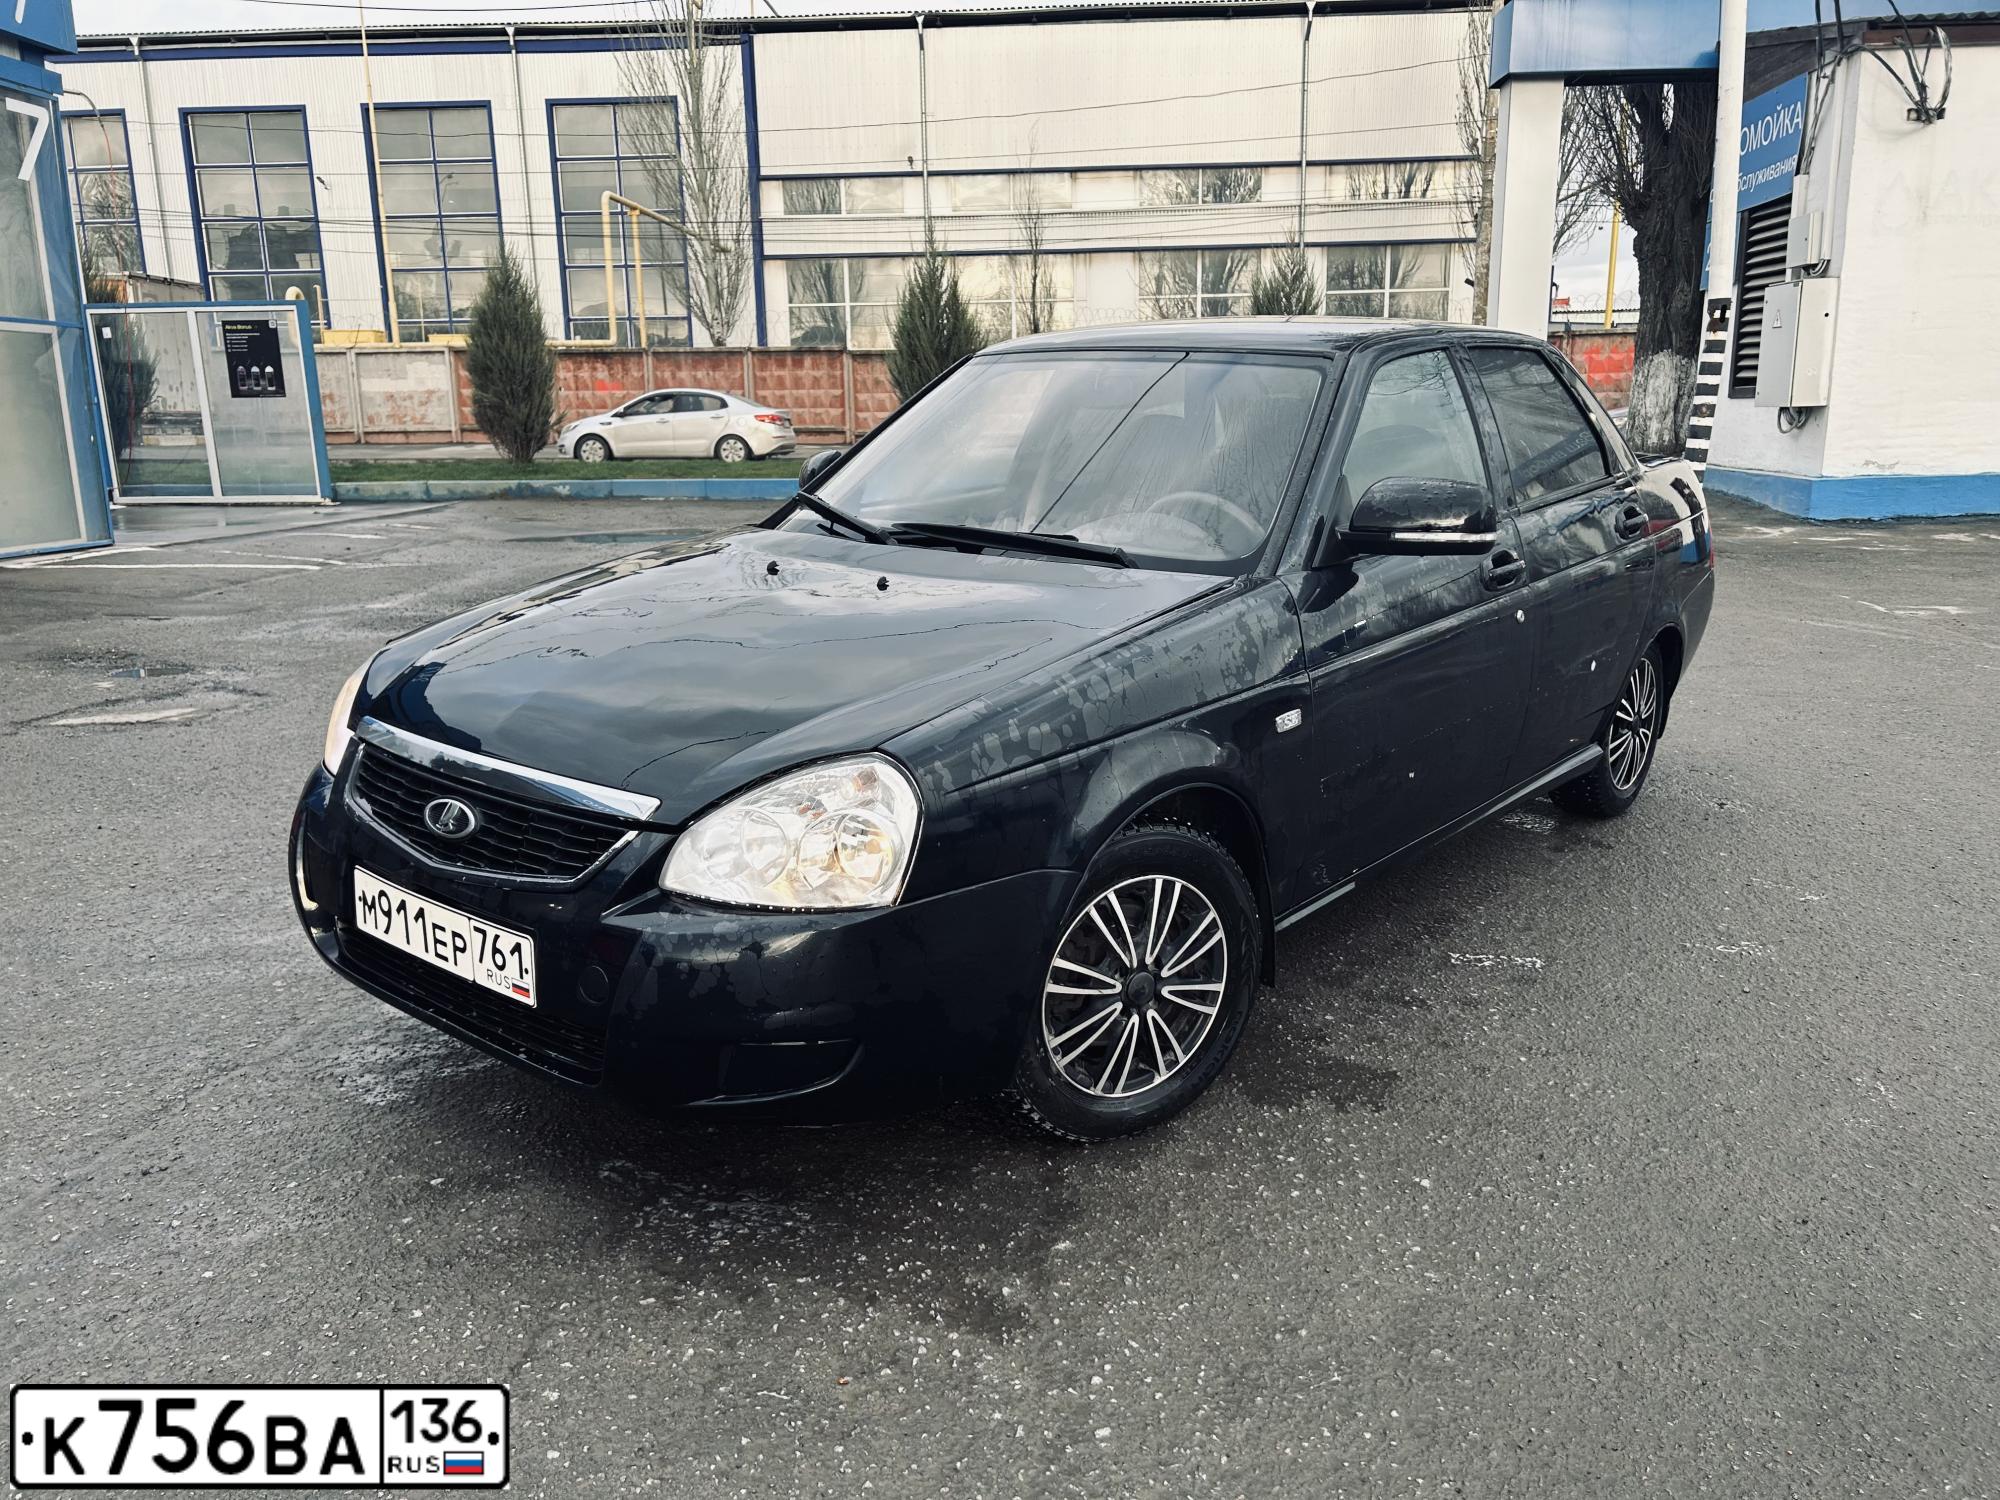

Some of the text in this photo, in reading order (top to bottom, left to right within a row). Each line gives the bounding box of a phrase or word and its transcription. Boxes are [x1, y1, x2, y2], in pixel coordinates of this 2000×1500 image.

[6, 97, 50, 181] 7
[1740, 101, 1802, 156] ОМОЙКА
[1738, 154, 1798, 192] бслуживания
[362, 889, 524, 979] М911ЕР 761
[486, 969, 511, 989] RUS
